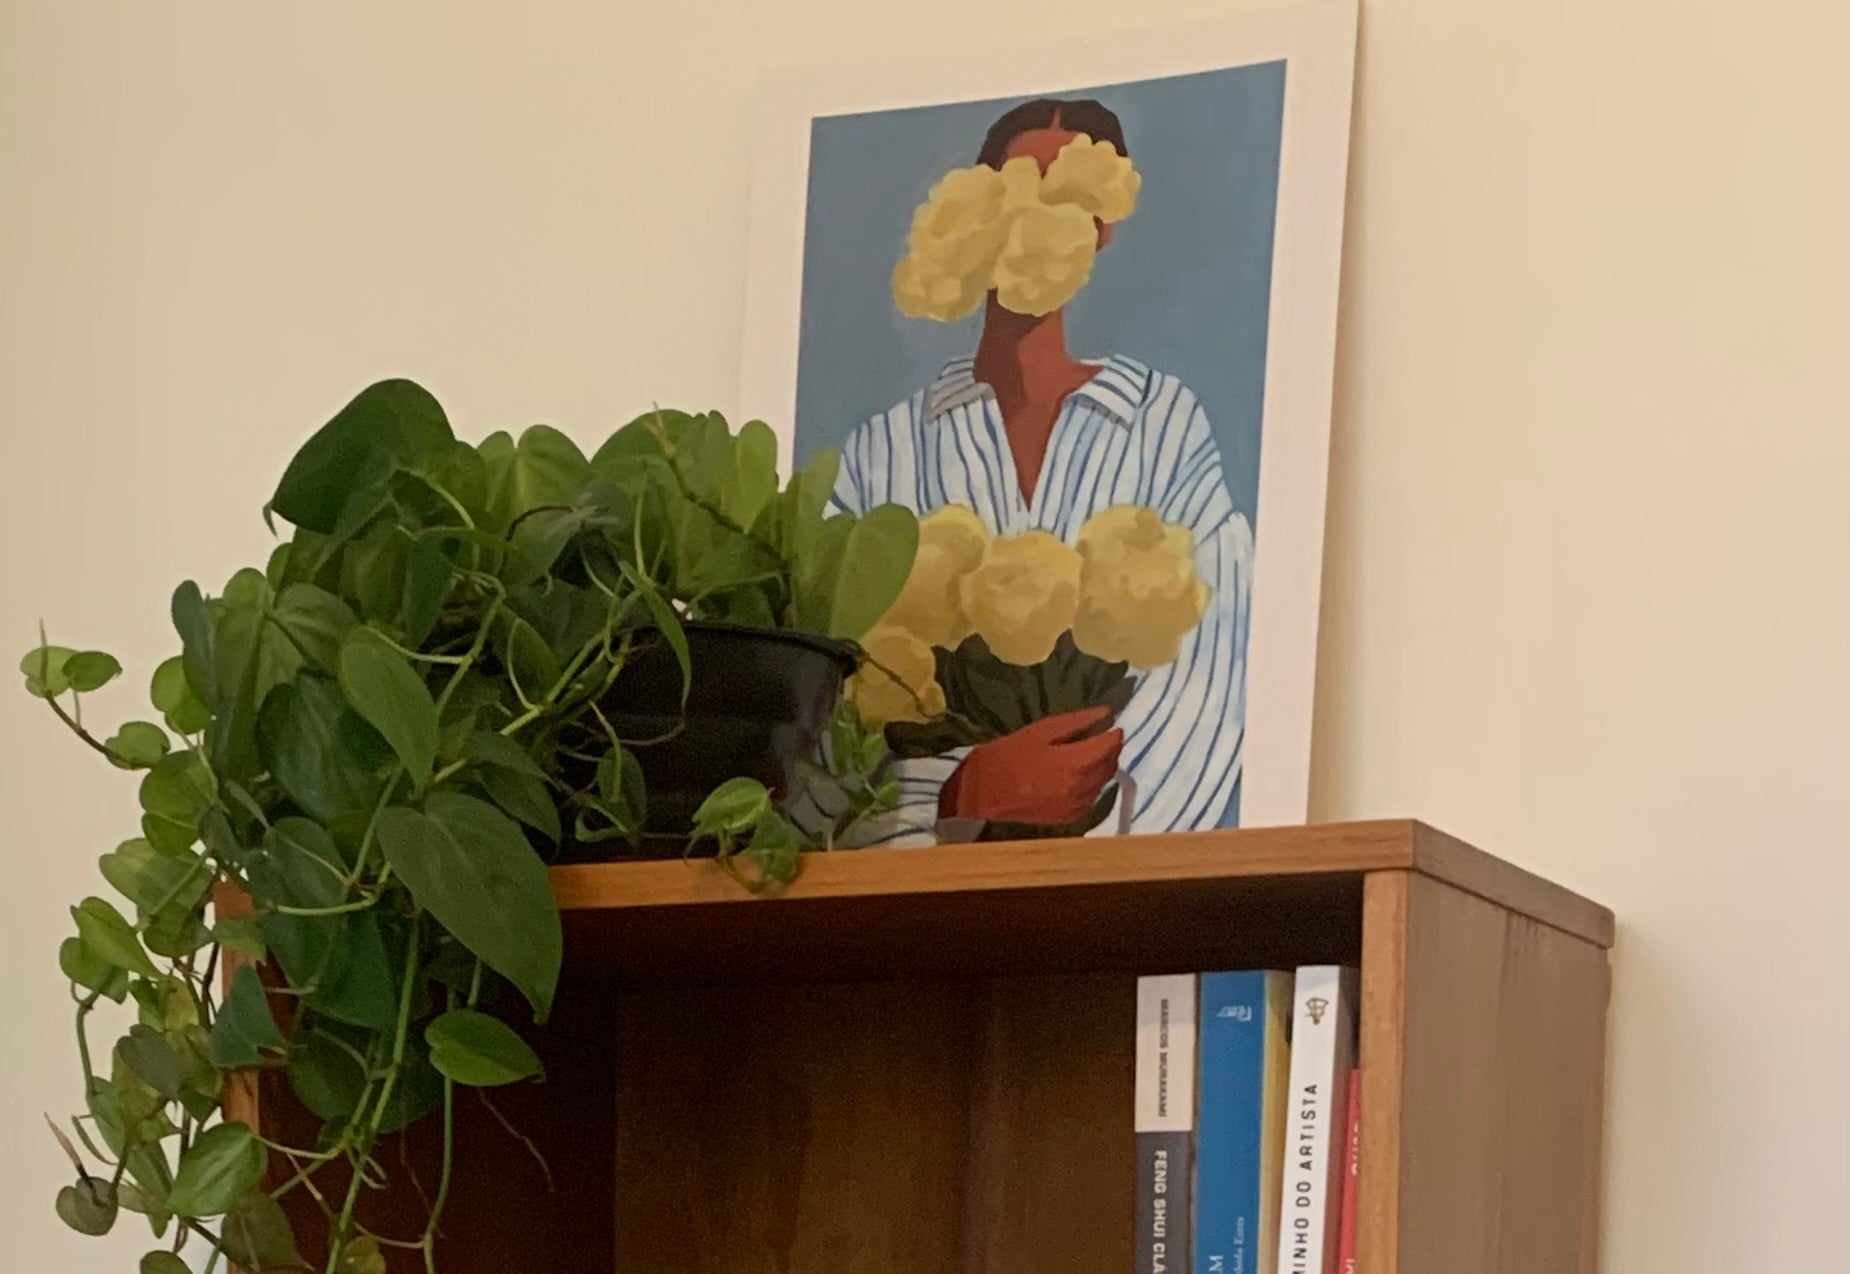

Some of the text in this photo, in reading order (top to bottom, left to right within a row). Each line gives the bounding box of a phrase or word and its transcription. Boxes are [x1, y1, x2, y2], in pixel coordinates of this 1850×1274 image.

[1158, 998, 1170, 1049] MARCOS
[1299, 1084, 1318, 1172] ARTISTA
[1153, 1149, 1168, 1194] FENG
[1295, 1181, 1312, 1208] DO
[1152, 1198, 1167, 1238] SHUI
